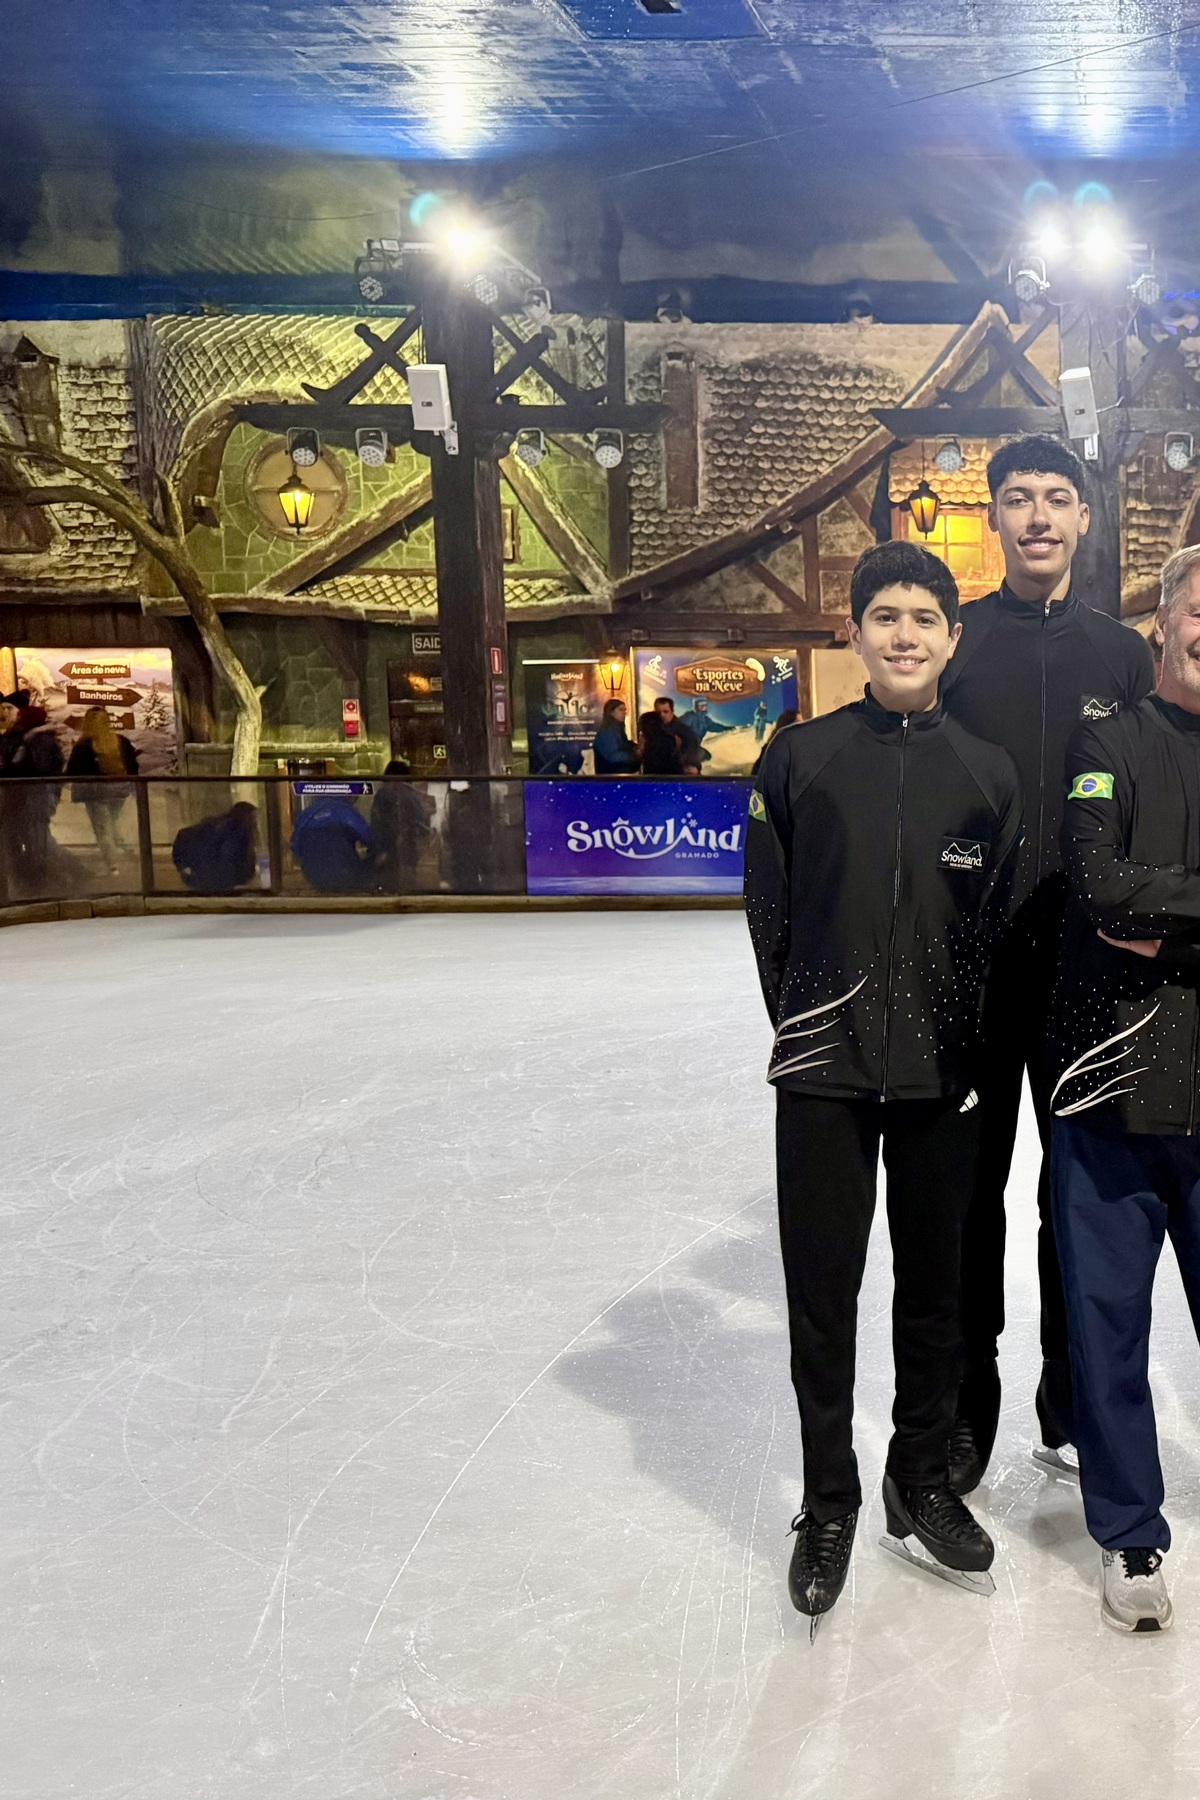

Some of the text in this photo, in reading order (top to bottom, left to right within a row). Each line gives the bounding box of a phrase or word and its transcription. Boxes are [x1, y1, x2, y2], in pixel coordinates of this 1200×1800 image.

[415, 635, 441, 649] SAÍD
[70, 663, 126, 675] Área de neve
[693, 667, 744, 683] Esportes
[695, 680, 743, 693] na Neve
[79, 691, 123, 701] Banheiros
[566, 817, 743, 859] Snowland
[675, 851, 720, 860] GRAMADO
[940, 850, 983, 867] Snowland
